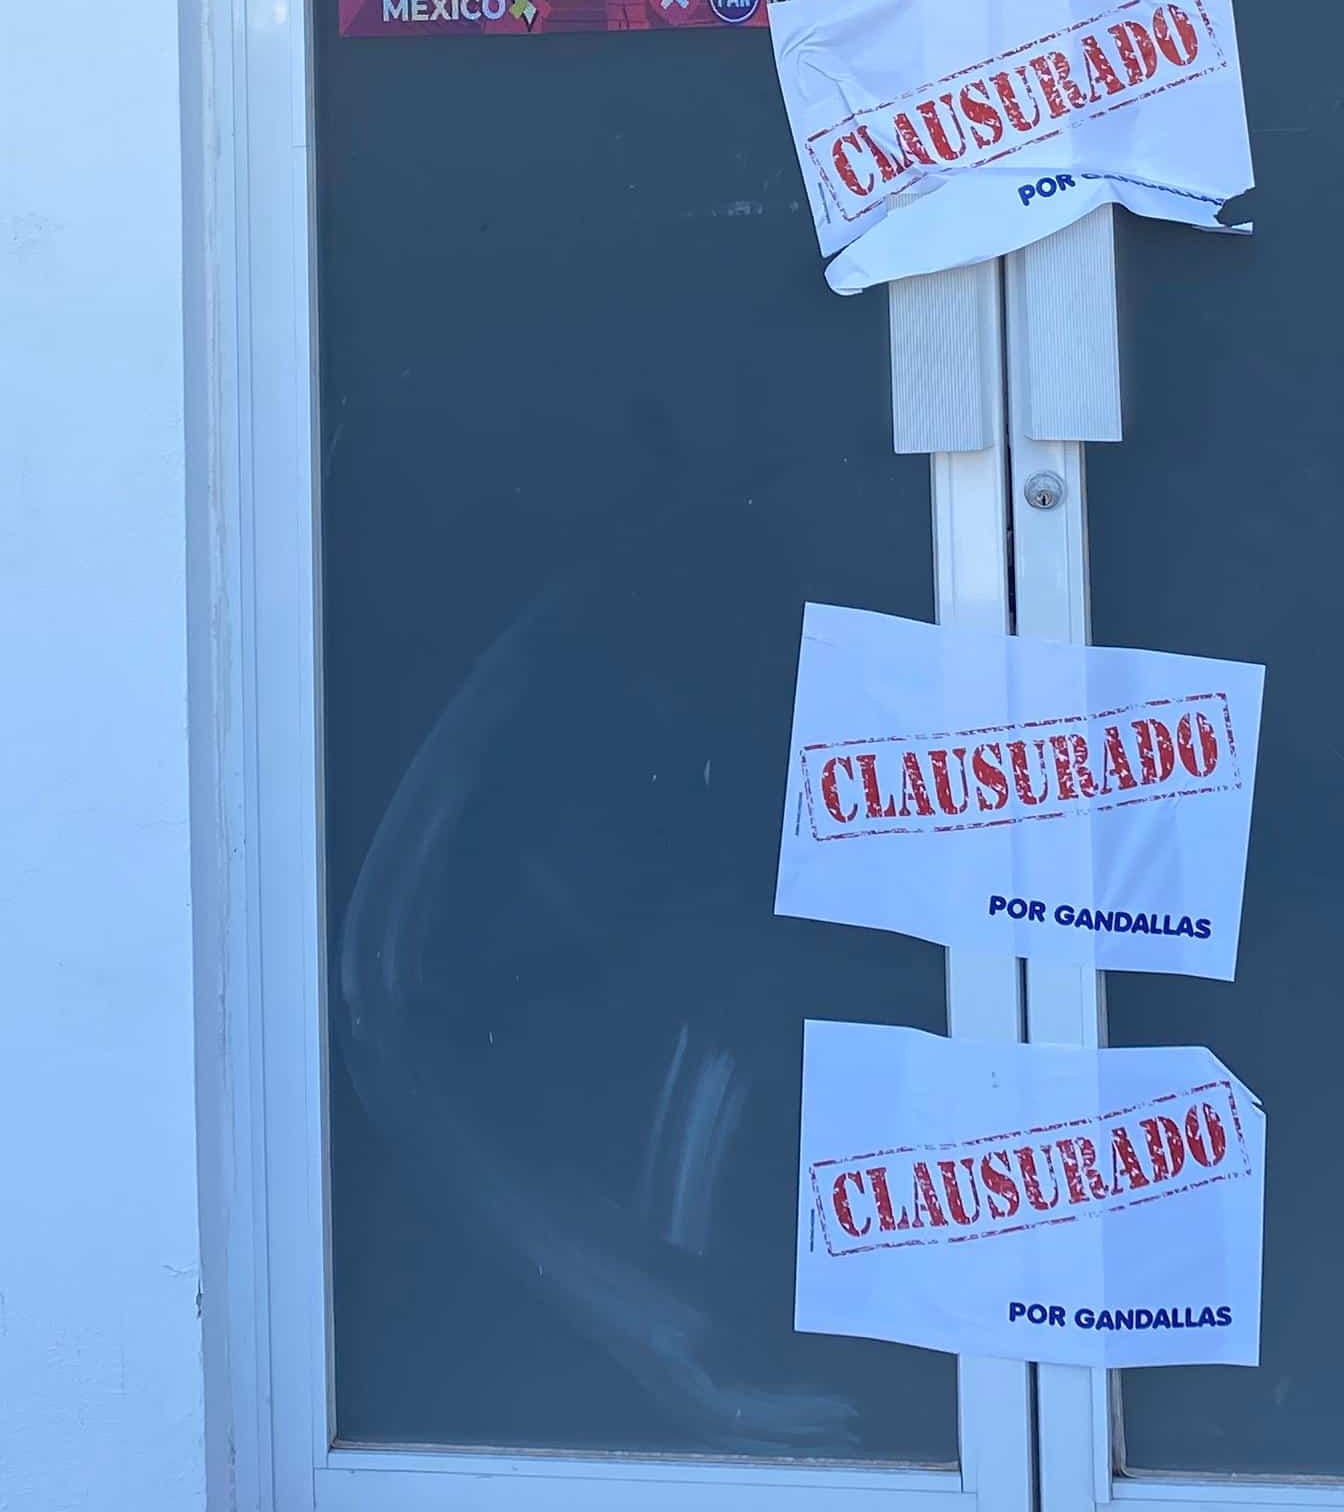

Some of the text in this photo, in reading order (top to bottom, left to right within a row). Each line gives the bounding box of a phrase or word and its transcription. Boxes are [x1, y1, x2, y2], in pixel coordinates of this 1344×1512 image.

[831, 2, 1200, 197] CLAUSURADO
[1017, 173, 1076, 206] POR
[821, 711, 1218, 824] CLAUSURADO
[989, 895, 1211, 939] POR GANDALLAS
[832, 1101, 1228, 1238] CLAUSURADO
[1008, 1302, 1233, 1331] POR GANDALLAS
